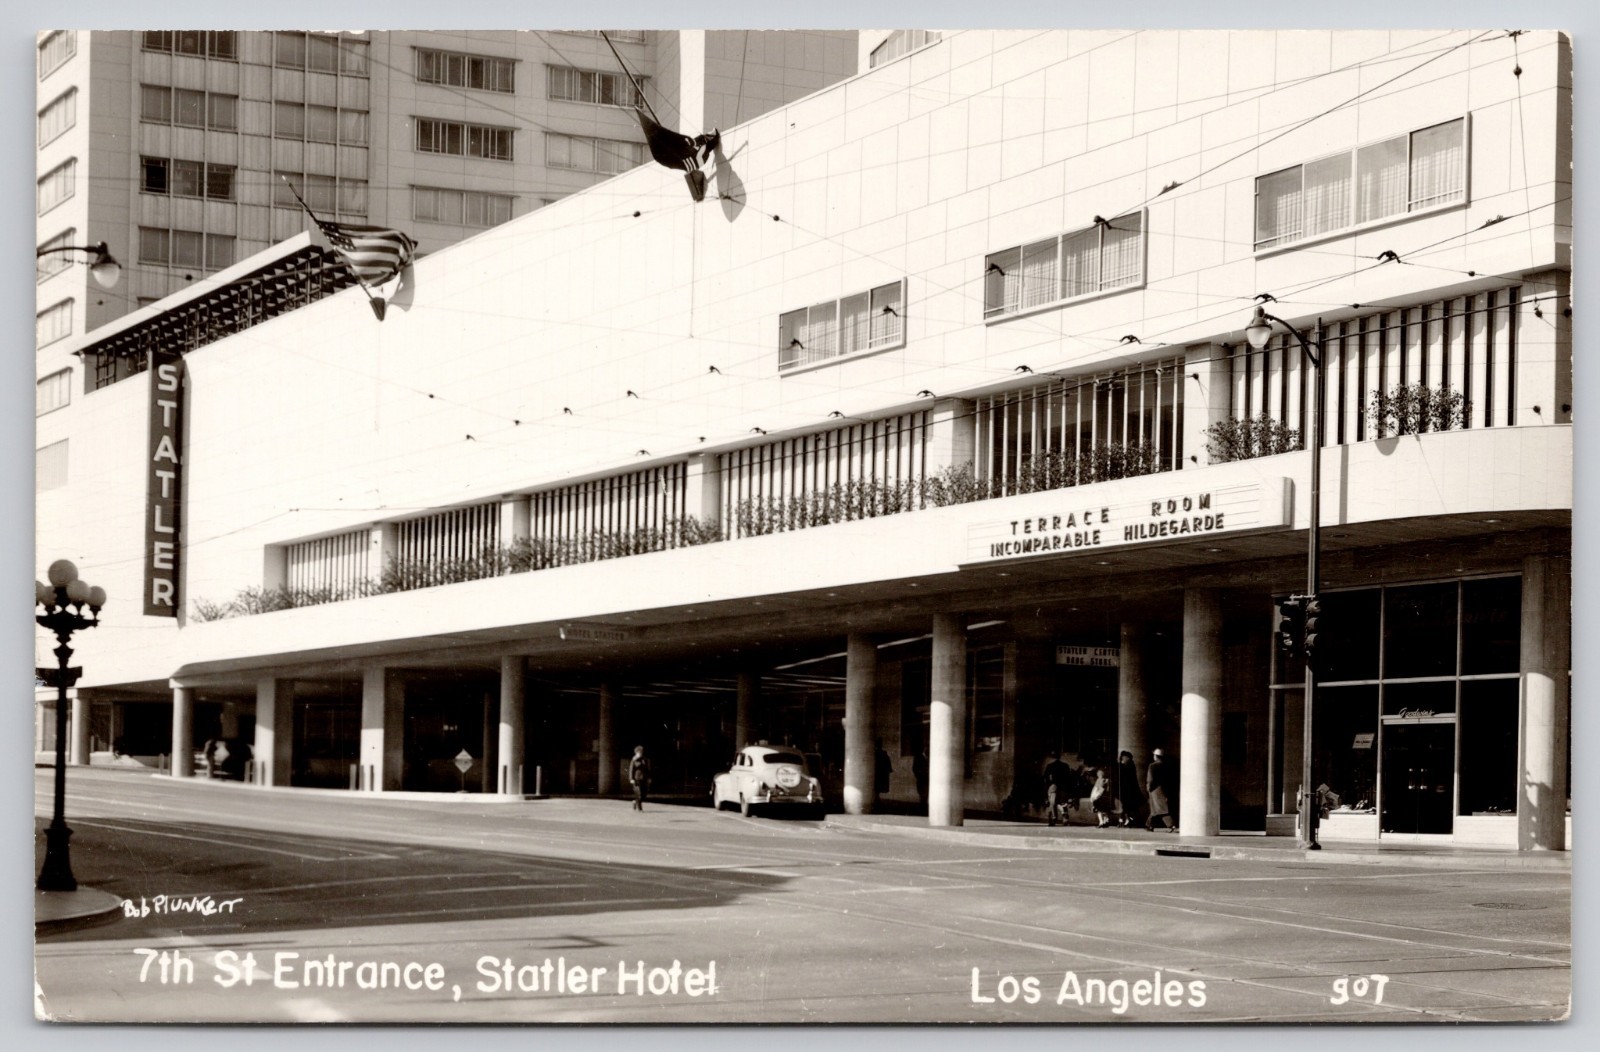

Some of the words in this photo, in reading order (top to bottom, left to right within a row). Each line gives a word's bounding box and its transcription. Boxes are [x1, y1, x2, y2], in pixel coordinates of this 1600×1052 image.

[153, 364, 178, 607] STATLER
[990, 529, 1102, 557] INCOMPARABLE
[1123, 512, 1225, 542] HILDEGARDE
[1010, 507, 1109, 536] TERRACE
[1151, 493, 1211, 517] ROOM
[1058, 647, 1087, 655] STATLER
